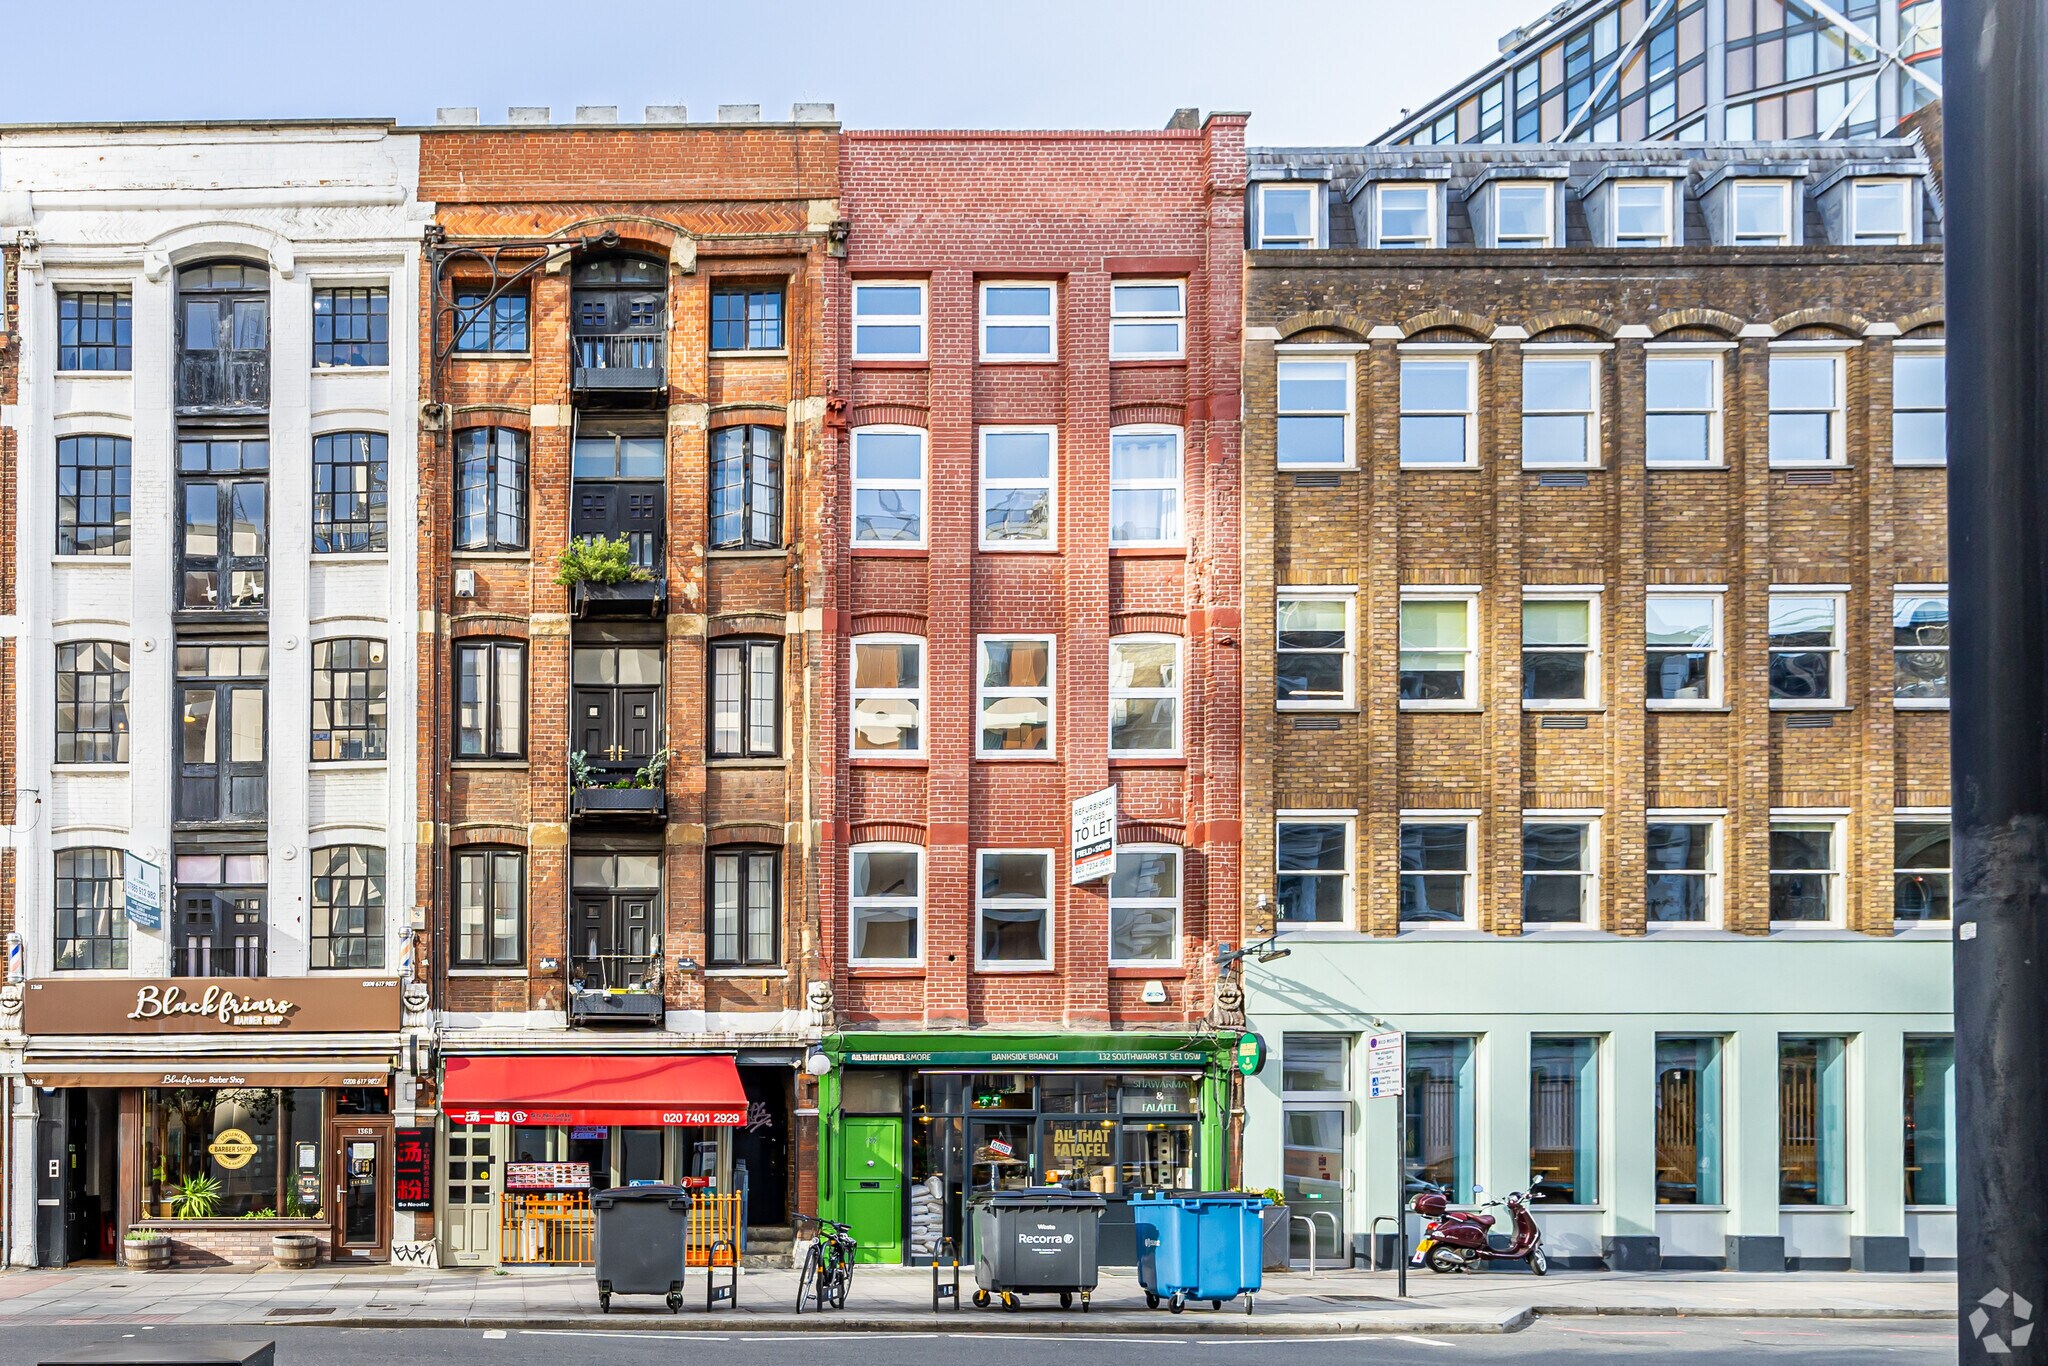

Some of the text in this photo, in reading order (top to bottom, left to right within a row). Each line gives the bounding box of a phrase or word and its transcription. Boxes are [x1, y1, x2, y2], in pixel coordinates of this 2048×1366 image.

[1074, 797, 1112, 816] REFURBISHED
[1082, 811, 1106, 824] OFFICES
[1074, 819, 1112, 842] TO LET
[1076, 849, 1092, 859] FIELD
[1094, 841, 1111, 853] SONS
[127, 985, 293, 1023] Blackfriars
[234, 1015, 284, 1025] BARBER SHOP
[229, 1076, 245, 1084] Shop
[1156, 1092, 1164, 1100] &
[450, 1111, 510, 1122] 一汤一粉
[663, 1113, 740, 1123] 020 7401 2929
[1054, 1130, 1110, 1142] ALL THAT
[992, 1141, 1010, 1153] CLOSED
[1054, 1144, 1110, 1156] FALAFEL
[397, 1131, 422, 1200] 一汤一粉
[1076, 1160, 1085, 1169] &
[1019, 1234, 1062, 1243] Recorra
